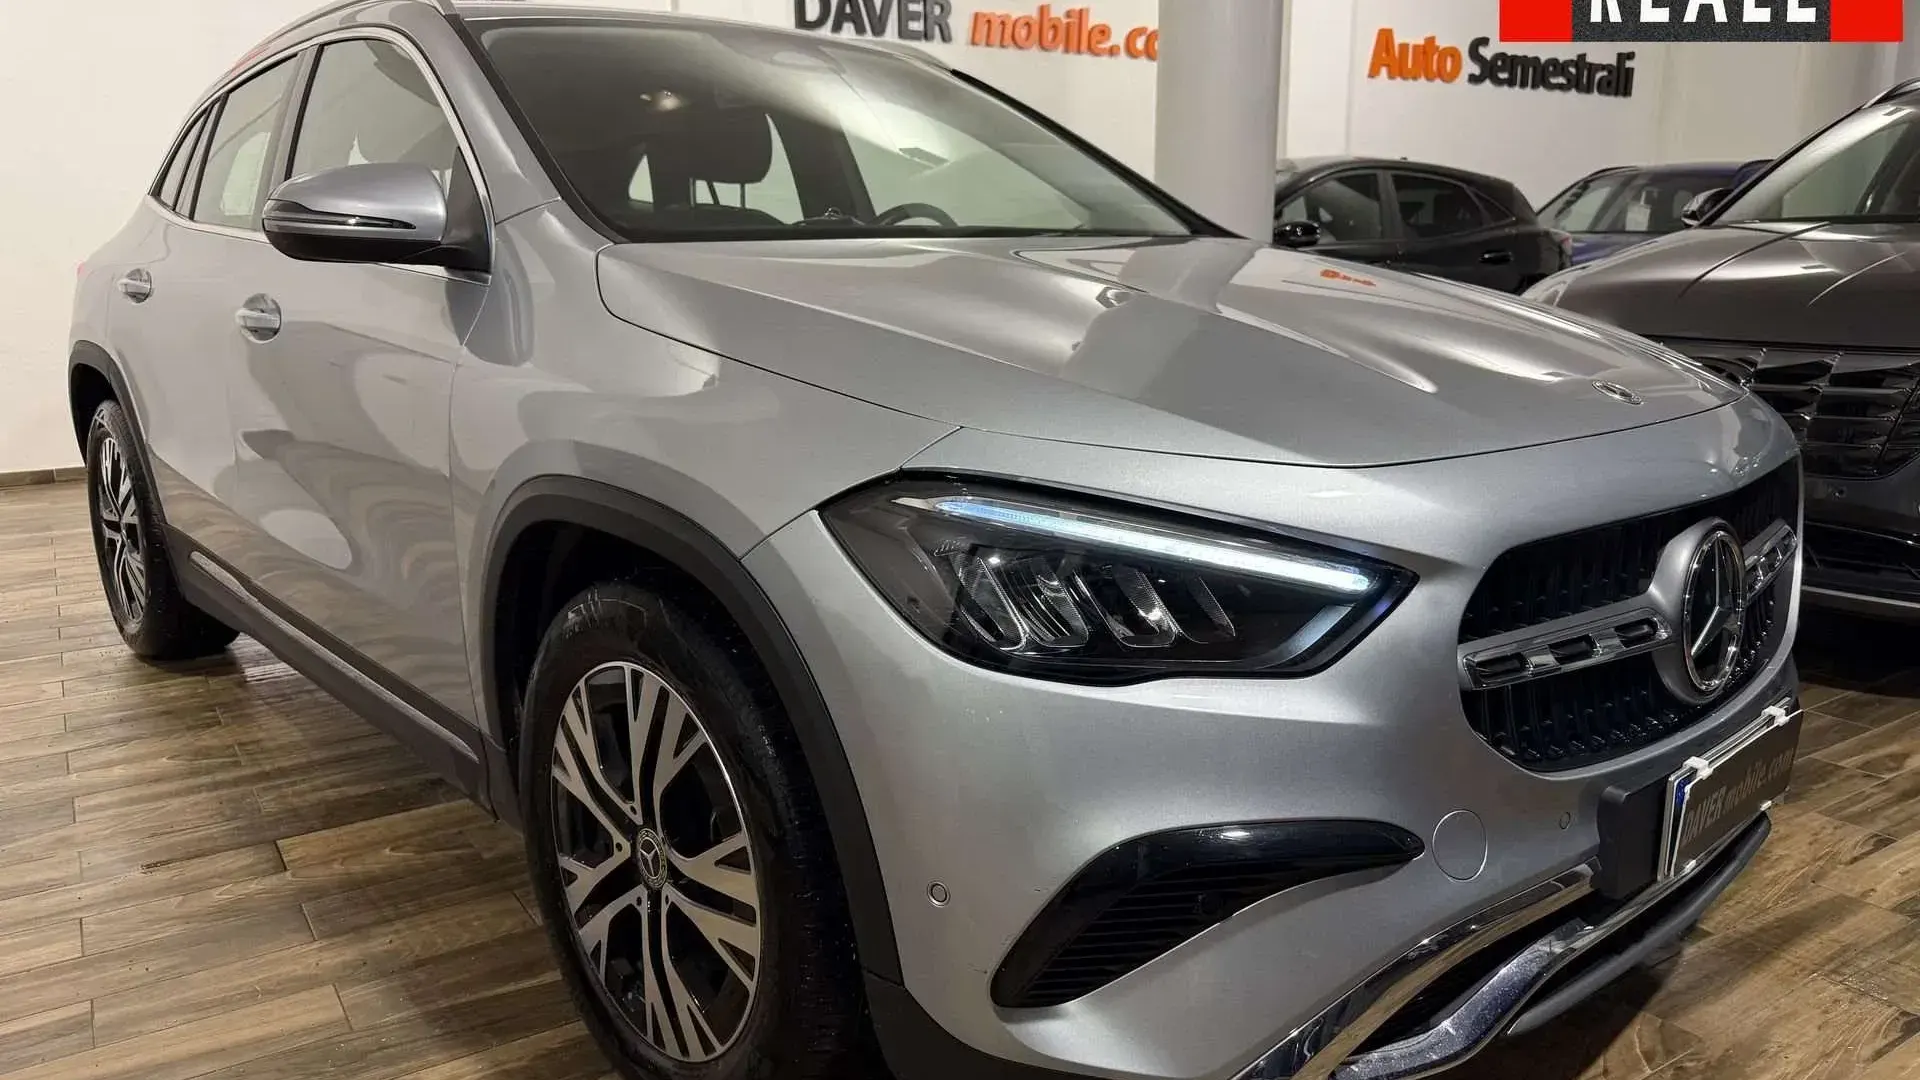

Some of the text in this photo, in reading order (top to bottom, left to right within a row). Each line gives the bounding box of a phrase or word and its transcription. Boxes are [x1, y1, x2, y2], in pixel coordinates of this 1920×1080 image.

[795, 0, 952, 43] DAVER
[1368, 28, 1636, 98] Auto Semestrali
